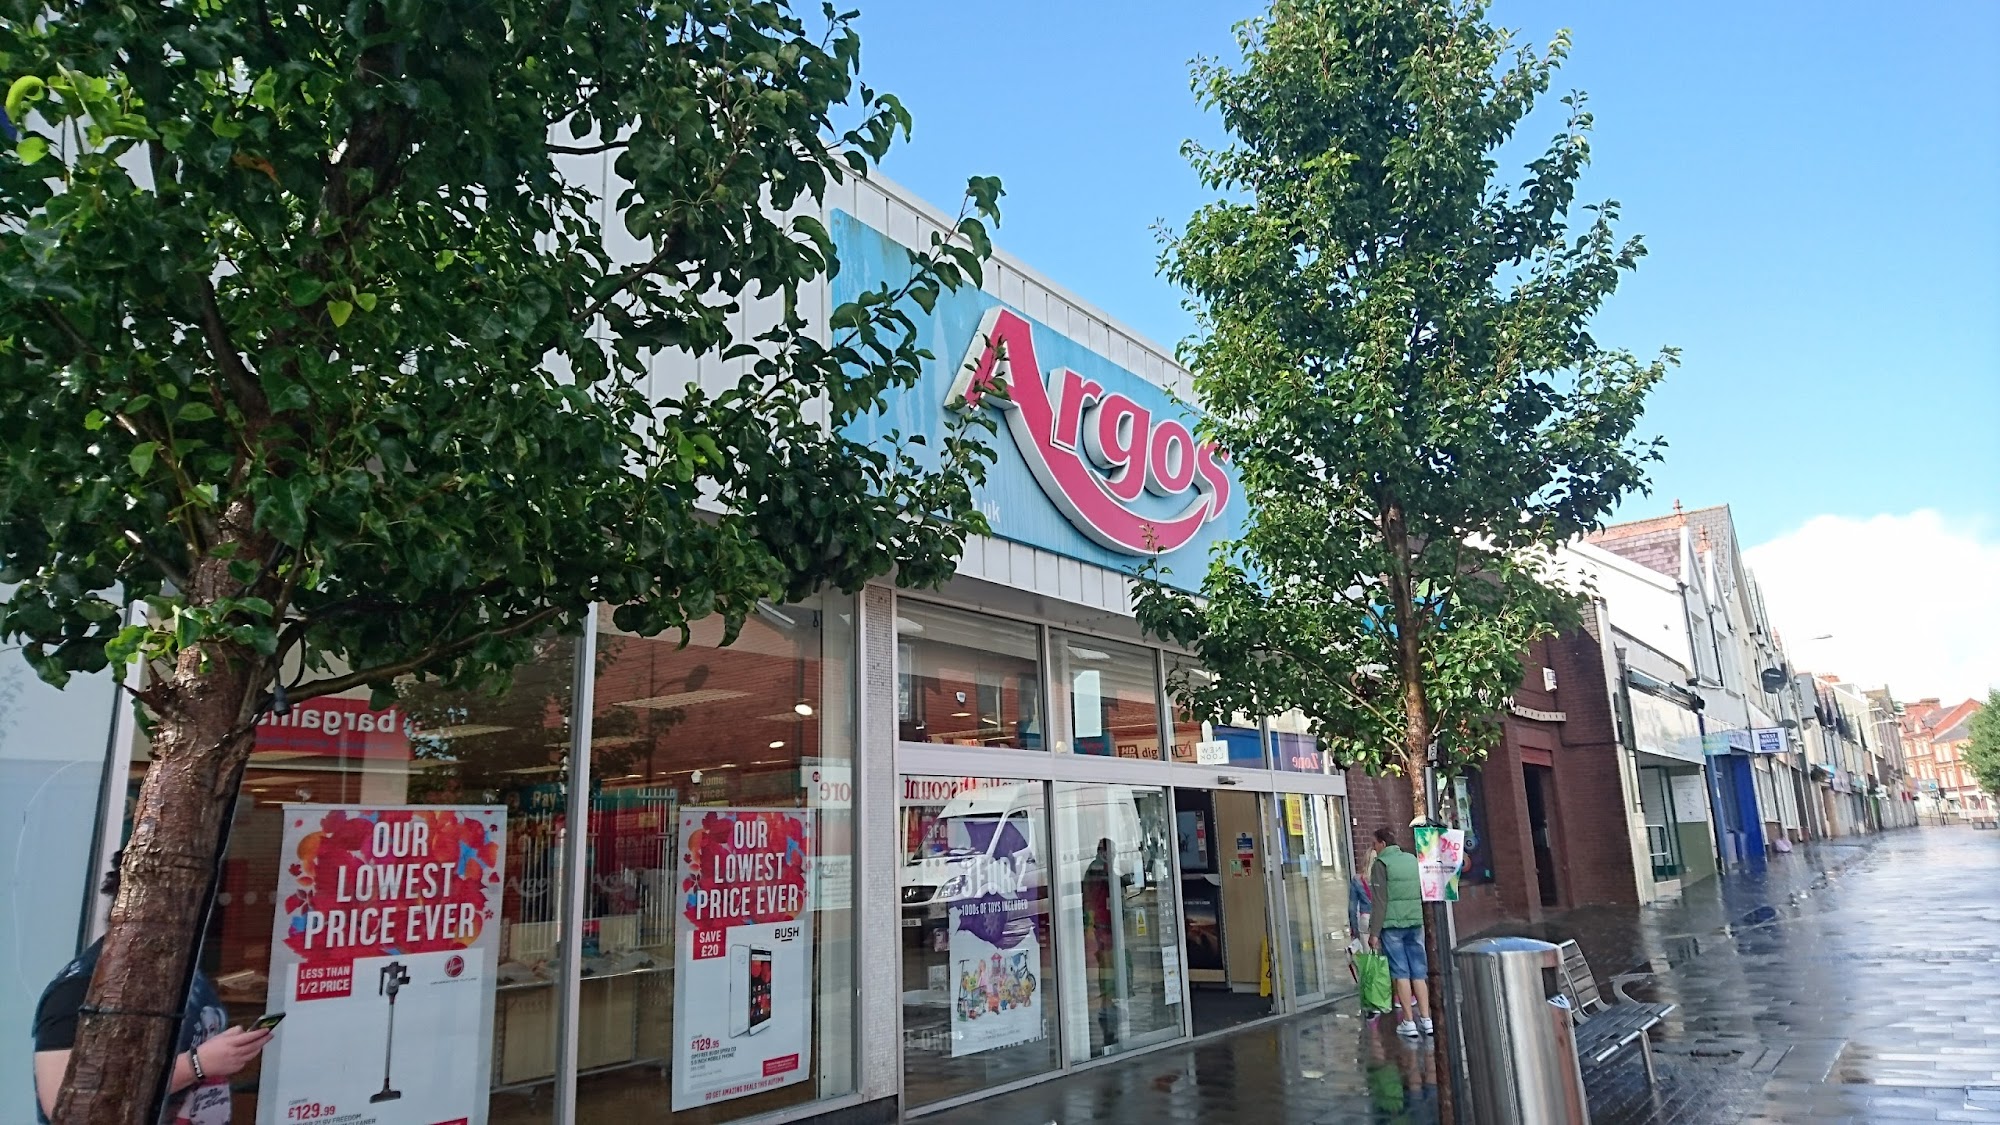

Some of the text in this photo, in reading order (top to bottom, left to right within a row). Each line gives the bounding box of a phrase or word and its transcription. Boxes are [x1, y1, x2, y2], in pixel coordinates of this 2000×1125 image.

[945, 305, 1230, 556] Argos
[533, 790, 557, 810] Pay
[371, 821, 430, 858] OUR
[733, 820, 768, 849] OUR
[934, 824, 947, 839] FO
[714, 852, 785, 884] LOWEST
[962, 856, 1028, 897] 3 FOR 2
[336, 862, 456, 903] LOWEST
[696, 884, 799, 920] PRICE EVER
[962, 899, 1029, 916] 1000s OF TOYS INCLUDED
[304, 902, 476, 950] PRICE EVER
[774, 926, 800, 940] BUSH
[699, 930, 721, 943] SAVE
[701, 944, 719, 958] £20
[300, 965, 350, 979] LESS THAN
[299, 978, 349, 995] 1/2 PRICE
[691, 1037, 720, 1051] £129.95
[712, 1090, 722, 1099] GET
[722, 1086, 743, 1097] AMAZING
[743, 1083, 758, 1091] DEALS
[768, 1075, 785, 1087] AUTUMN
[287, 1102, 336, 1121] £129.99
[332, 1113, 362, 1124] FREEDOM
